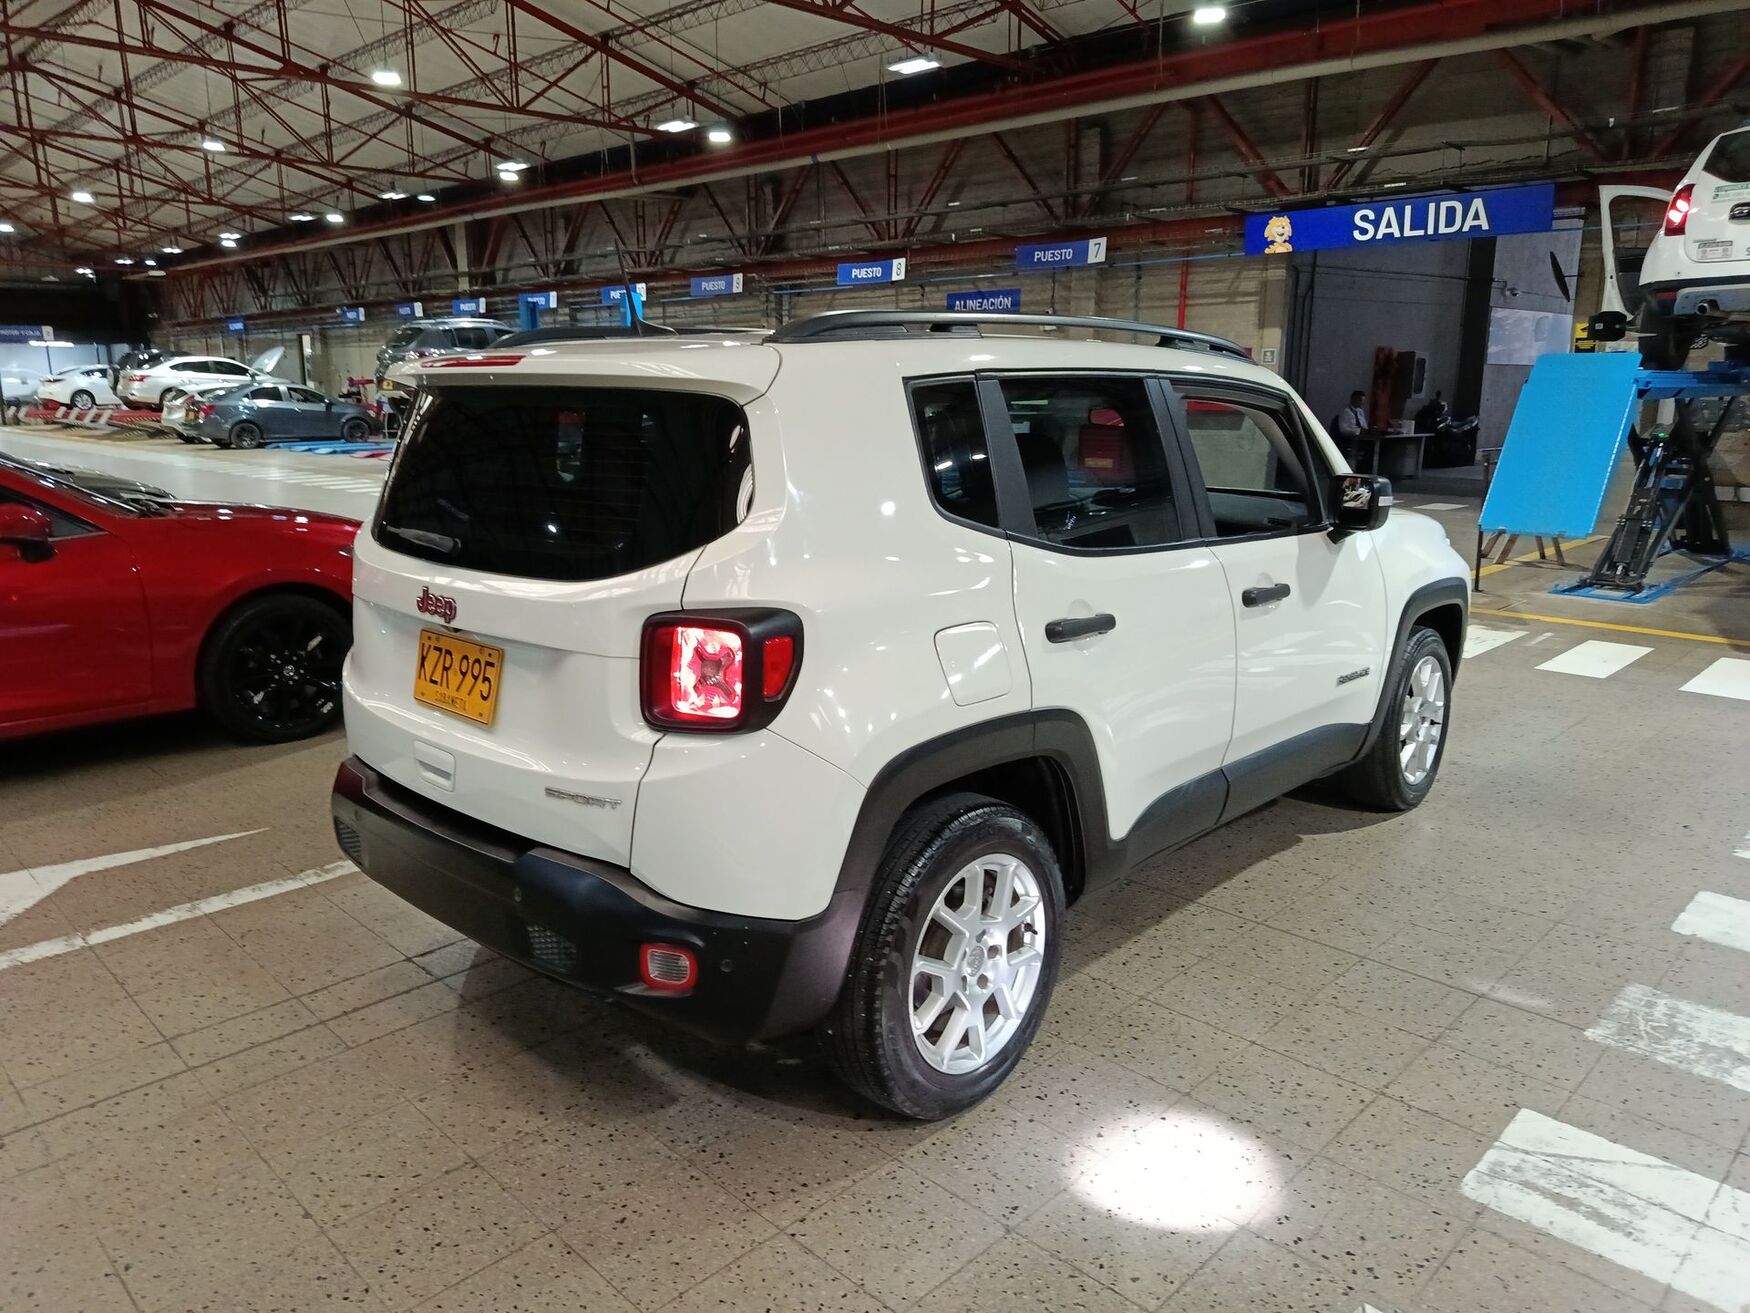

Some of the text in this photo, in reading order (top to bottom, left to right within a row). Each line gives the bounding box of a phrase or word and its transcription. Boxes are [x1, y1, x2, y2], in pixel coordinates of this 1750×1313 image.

[1352, 198, 1489, 241] SALIDA
[1033, 242, 1102, 263] PUESTO 7
[851, 266, 882, 279] PUESTO
[954, 294, 1012, 312] ALINEACIÓN
[416, 585, 457, 624] Jeep
[418, 642, 496, 702] KZR 995
